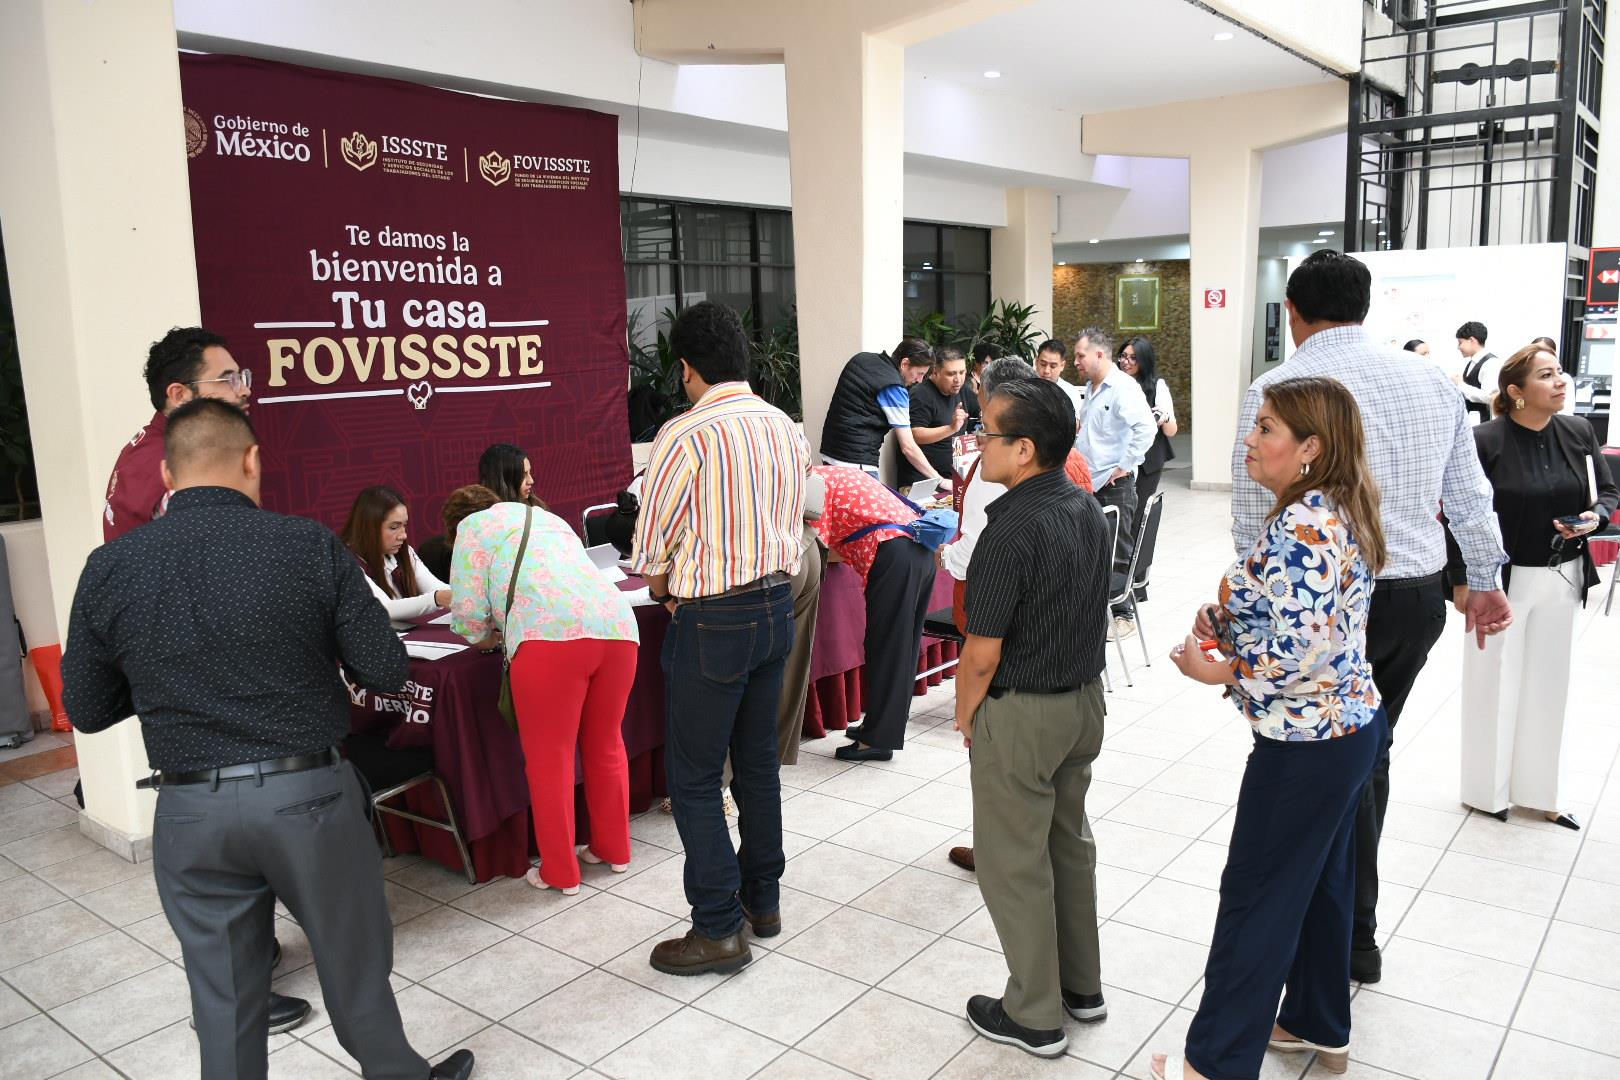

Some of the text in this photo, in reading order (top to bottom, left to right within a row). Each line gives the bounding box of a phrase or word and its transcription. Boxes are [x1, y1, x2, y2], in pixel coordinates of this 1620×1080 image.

[214, 115, 310, 137] Gobierno de
[214, 131, 311, 162] México
[381, 135, 448, 161] ISSSTE
[513, 155, 591, 174] FOVISSSTE
[344, 224, 470, 252] Te damos la
[309, 249, 503, 286] bienvenida a
[331, 291, 486, 329] Tu casa
[266, 333, 544, 387] FOVISSSTE
